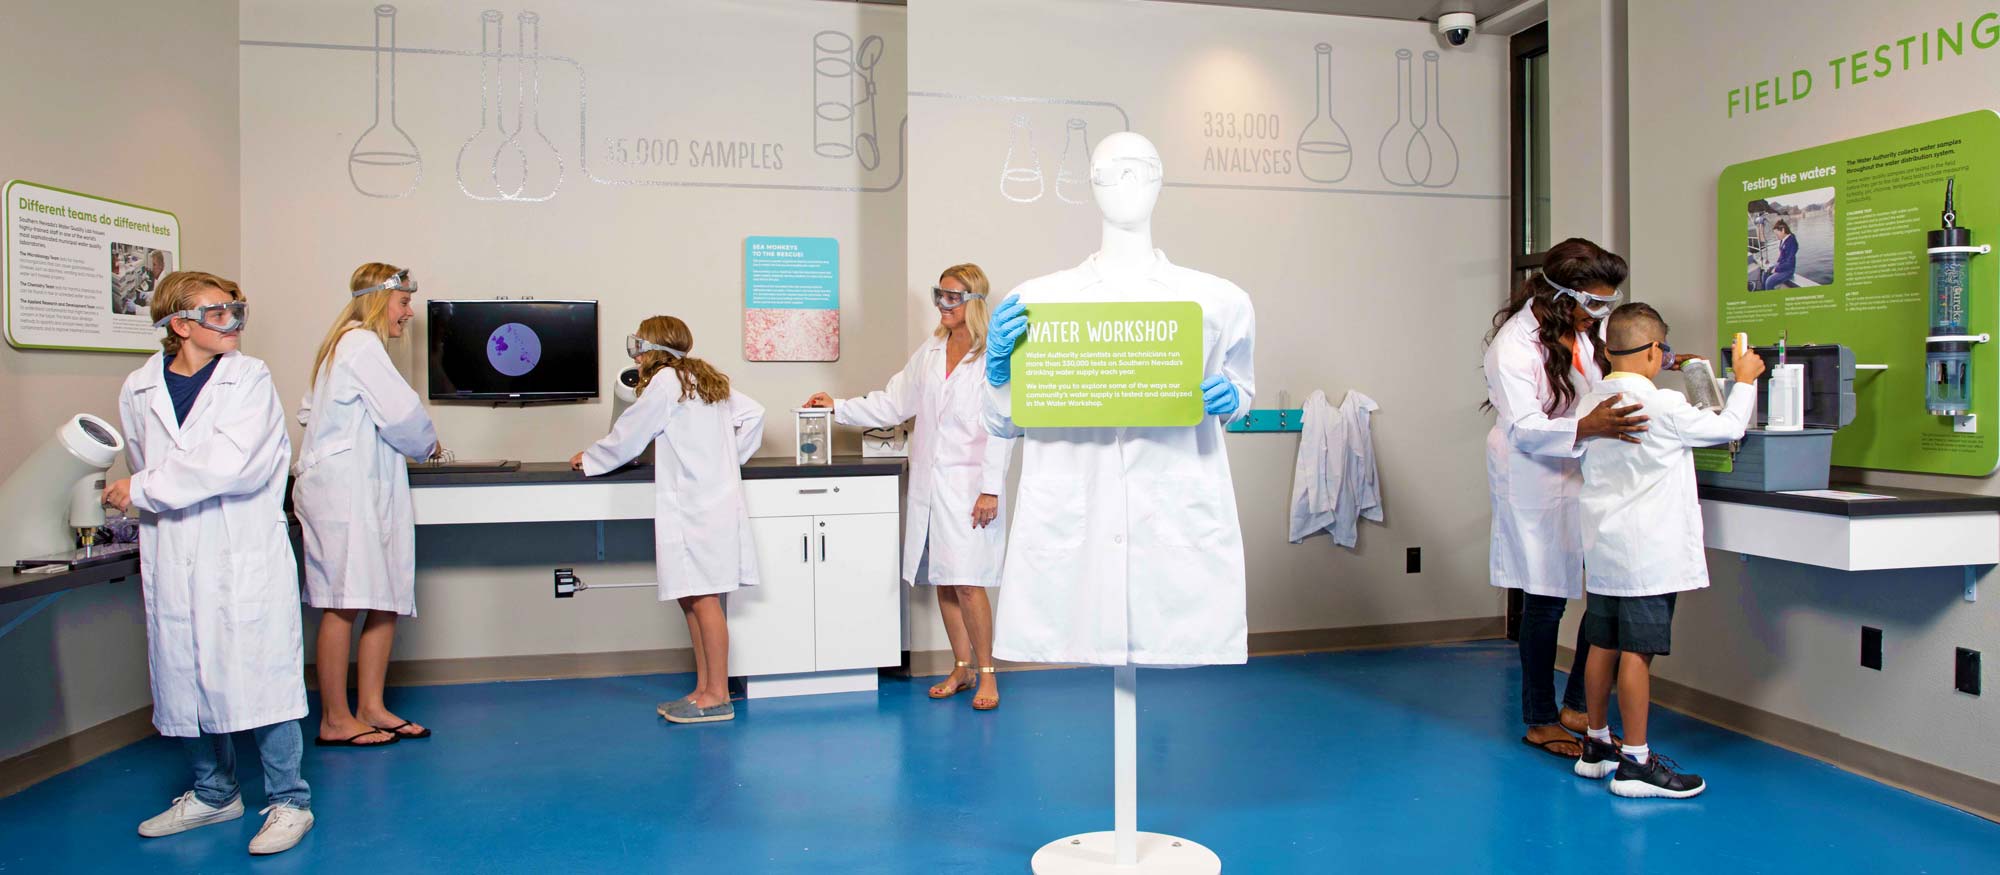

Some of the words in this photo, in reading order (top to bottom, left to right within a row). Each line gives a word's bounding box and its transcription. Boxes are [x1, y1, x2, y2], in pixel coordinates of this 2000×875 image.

[1728, 69, 1812, 118] FIELD
[1829, 12, 2000, 90] TESTING
[1204, 111, 1280, 142] 333,000
[688, 140, 784, 170] SAMPLES
[1203, 146, 1292, 174] ANALYSES
[1846, 164, 1874, 174] throughout
[1900, 153, 1932, 164] distribution
[1934, 149, 1955, 158] system.
[1873, 152, 1897, 161] Authority
[1898, 147, 1919, 156] collects
[1936, 139, 1962, 148] samples
[1742, 178, 1778, 192] Testing
[1780, 172, 1797, 184] the
[1800, 166, 1836, 181] waters
[19, 197, 66, 217] Different
[67, 207, 97, 223] teams
[99, 214, 111, 225] do
[114, 216, 150, 232] different
[152, 223, 170, 236] tests
[1027, 321, 1080, 343] WATER
[1086, 320, 1178, 342] WORKSHOP
